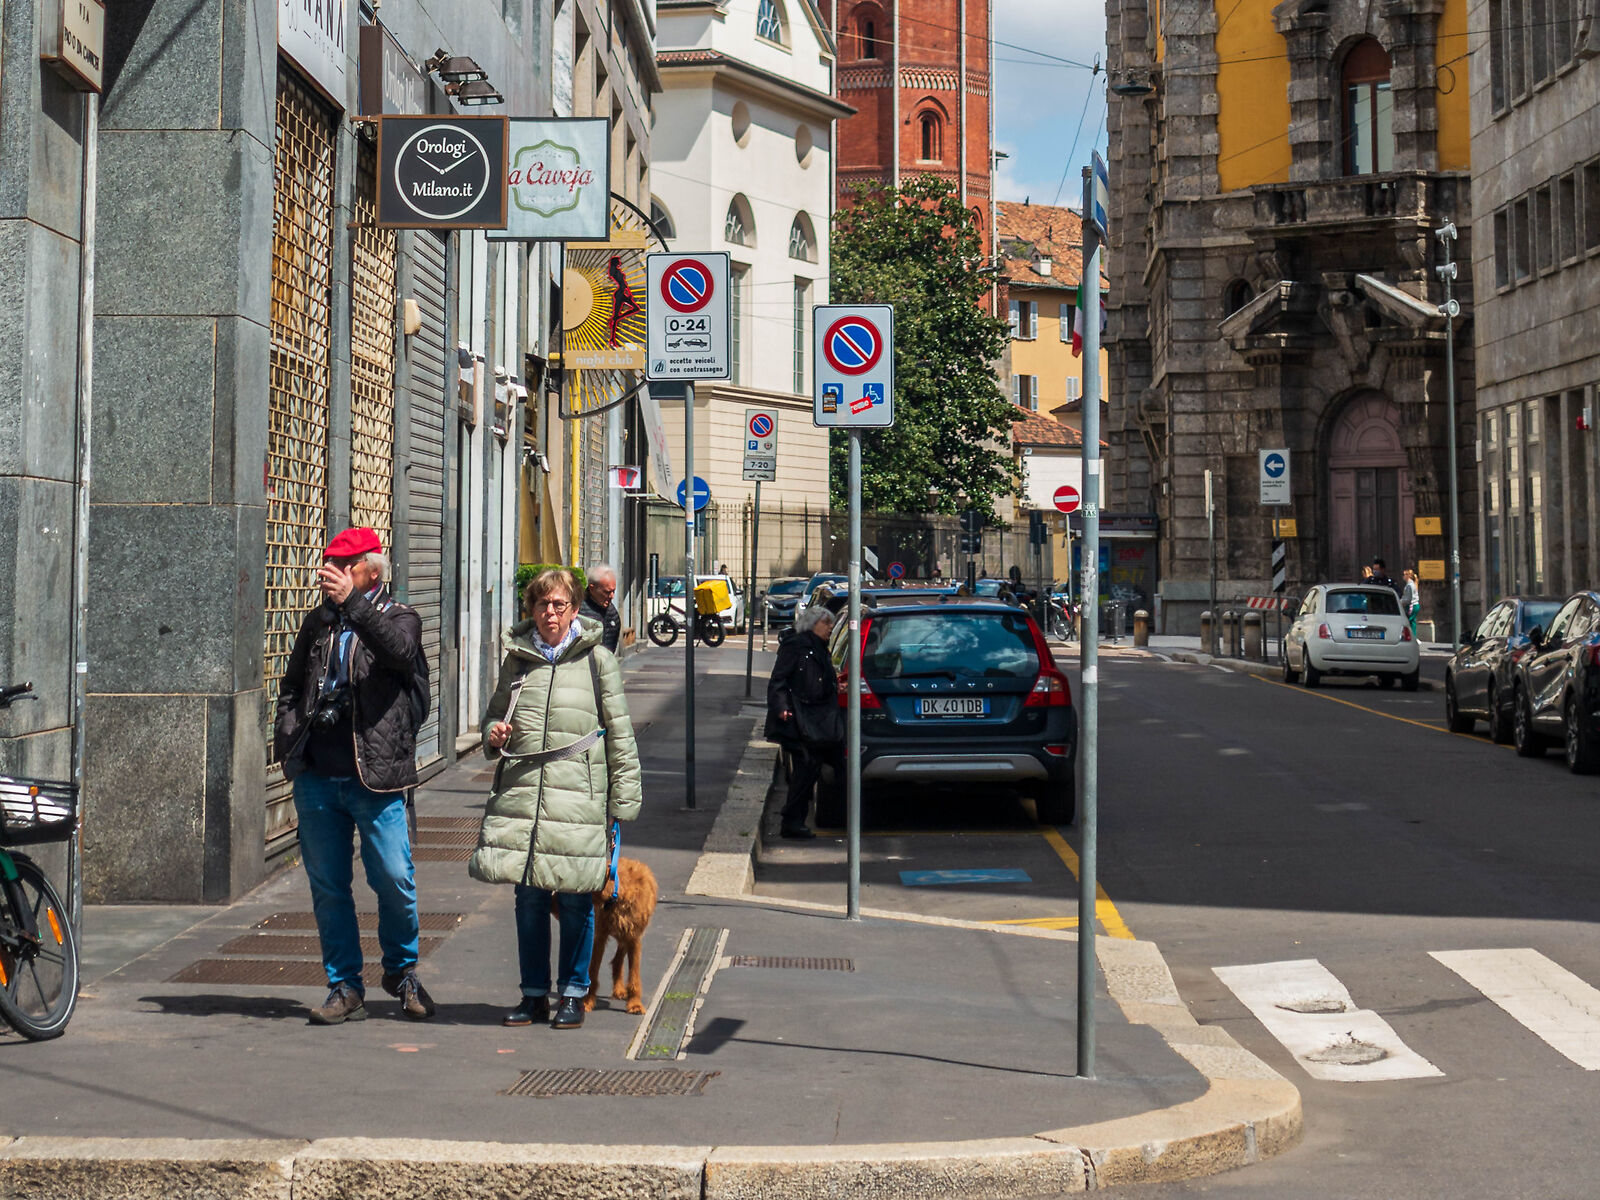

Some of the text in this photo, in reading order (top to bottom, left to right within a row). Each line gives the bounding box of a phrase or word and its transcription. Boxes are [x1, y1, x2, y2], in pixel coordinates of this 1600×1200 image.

[417, 138, 467, 158] Orologi
[508, 161, 594, 192] a Caveja
[413, 181, 473, 197] Milano.it
[669, 319, 706, 331] 0-24
[576, 352, 633, 367] night club
[750, 461, 769, 469] 7-20
[922, 699, 982, 713] DK 401DB
